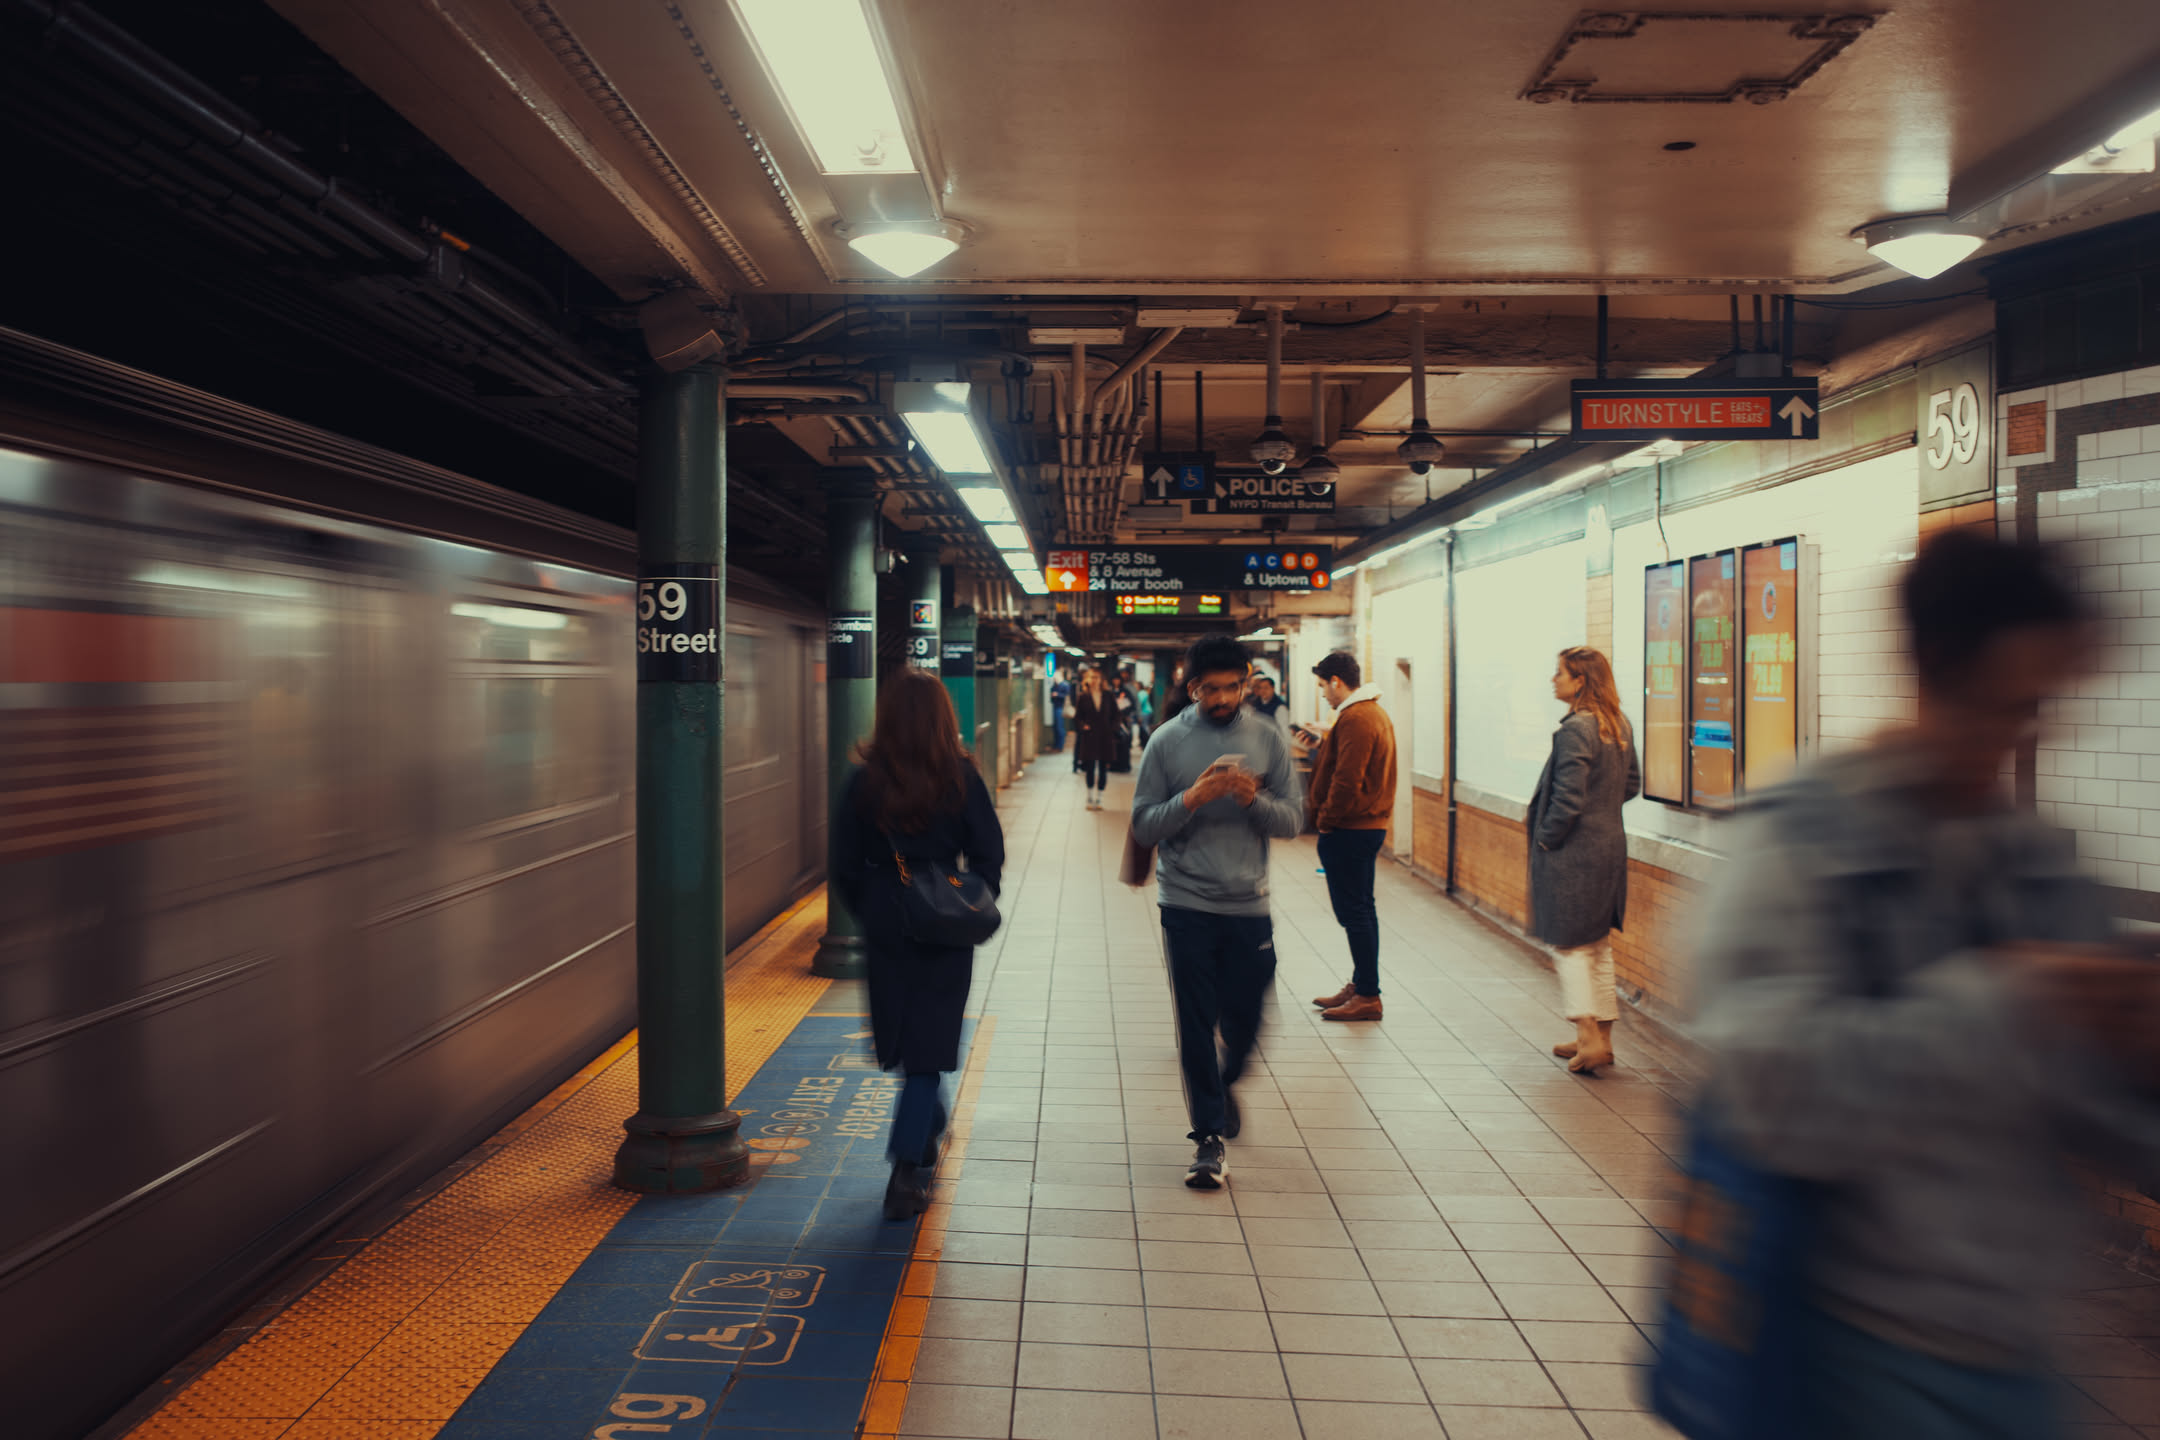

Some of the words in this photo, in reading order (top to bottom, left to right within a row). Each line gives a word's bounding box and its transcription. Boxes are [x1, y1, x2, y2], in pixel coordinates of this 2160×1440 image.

[1588, 402, 1724, 425] TURNSTYLE
[1730, 413, 1763, 423] TREATS
[1927, 382, 1980, 471] 59
[1230, 478, 1305, 496] POLICE
[1230, 499, 1258, 509] NYPD
[1261, 499, 1295, 509] Transit
[1298, 499, 1333, 509] Bureau
[1047, 552, 1085, 568] Exit
[1089, 552, 1131, 564] 57-58
[1133, 552, 1157, 565] Sts
[1089, 566, 1099, 577] &
[1102, 565, 1113, 577] 8
[1115, 566, 1163, 577] Avenue
[1088, 578, 1107, 590] 24
[1110, 578, 1141, 590] hour
[1144, 578, 1184, 590] booth
[1243, 572, 1254, 585] &
[1258, 573, 1310, 588] Uptown
[638, 581, 688, 622] 59
[638, 627, 717, 653] Street
[906, 638, 929, 655] 59
[832, 1077, 907, 1140] Elevator
